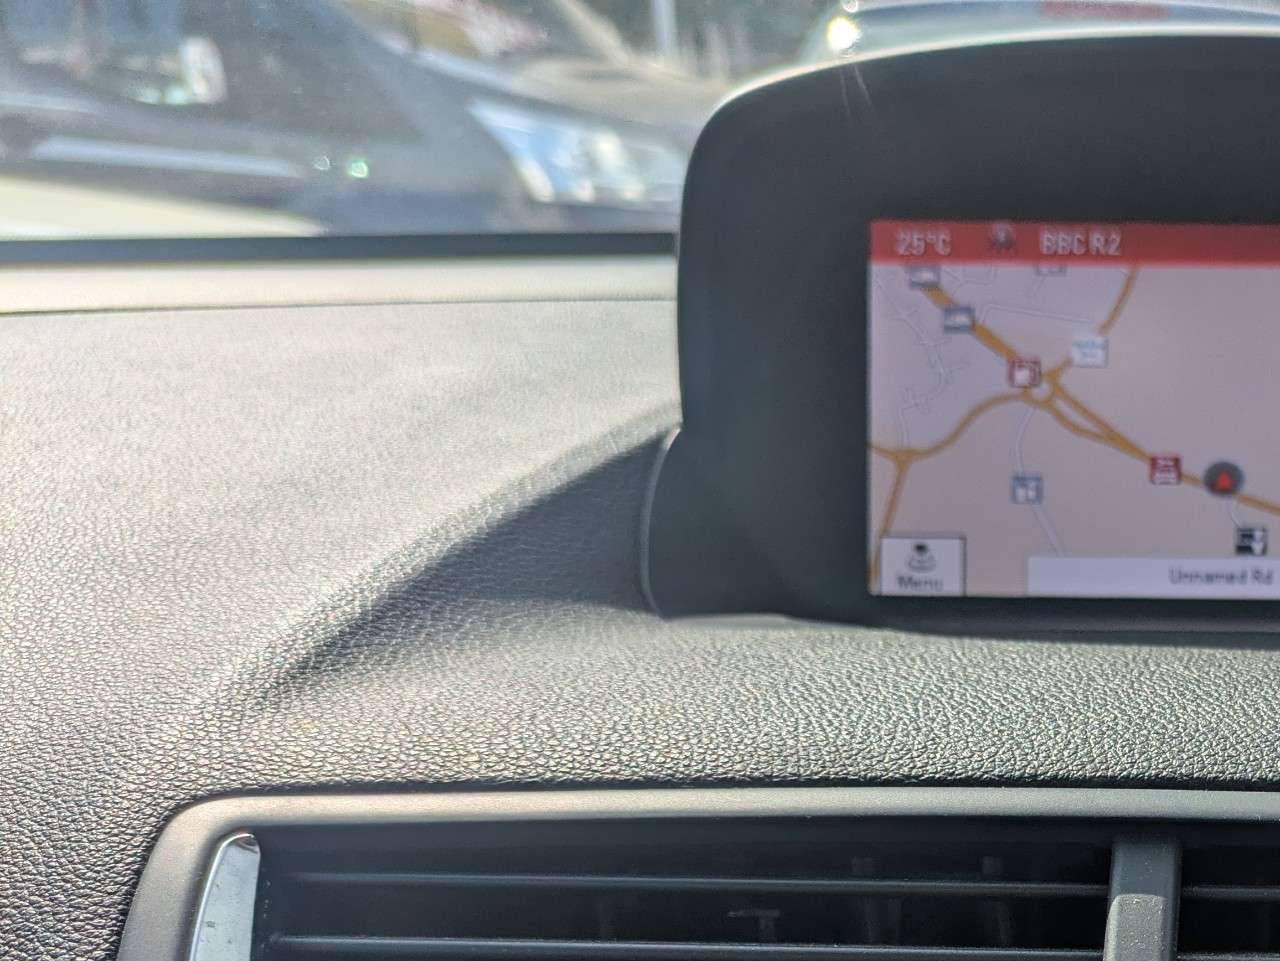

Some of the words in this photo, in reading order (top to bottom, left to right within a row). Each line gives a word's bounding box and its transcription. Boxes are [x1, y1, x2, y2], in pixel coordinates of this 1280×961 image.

[896, 230, 953, 257] 25°C
[1040, 230, 1086, 256] BBC
[1090, 231, 1122, 257] R2
[898, 573, 944, 592] Menu
